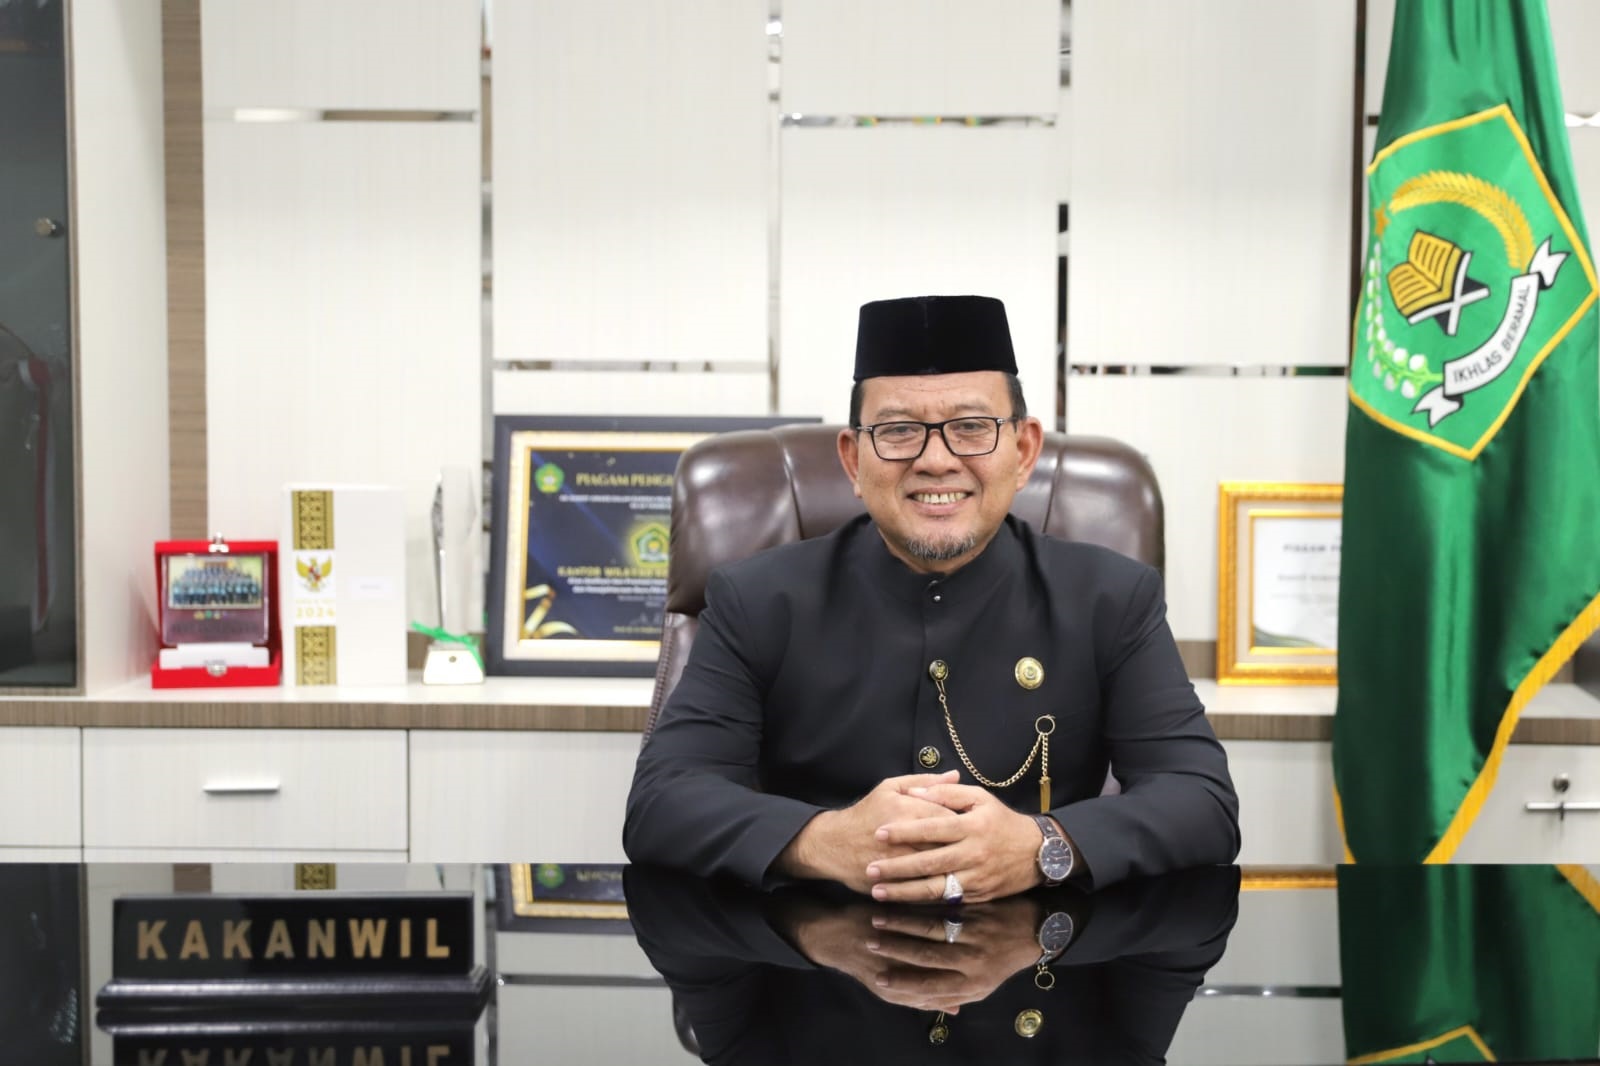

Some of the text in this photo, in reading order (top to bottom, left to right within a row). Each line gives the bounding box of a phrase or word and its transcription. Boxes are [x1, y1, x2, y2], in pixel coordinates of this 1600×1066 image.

[1453, 284, 1531, 383] IKHLAS BERAMAL
[137, 918, 450, 960] KAKANWIL
